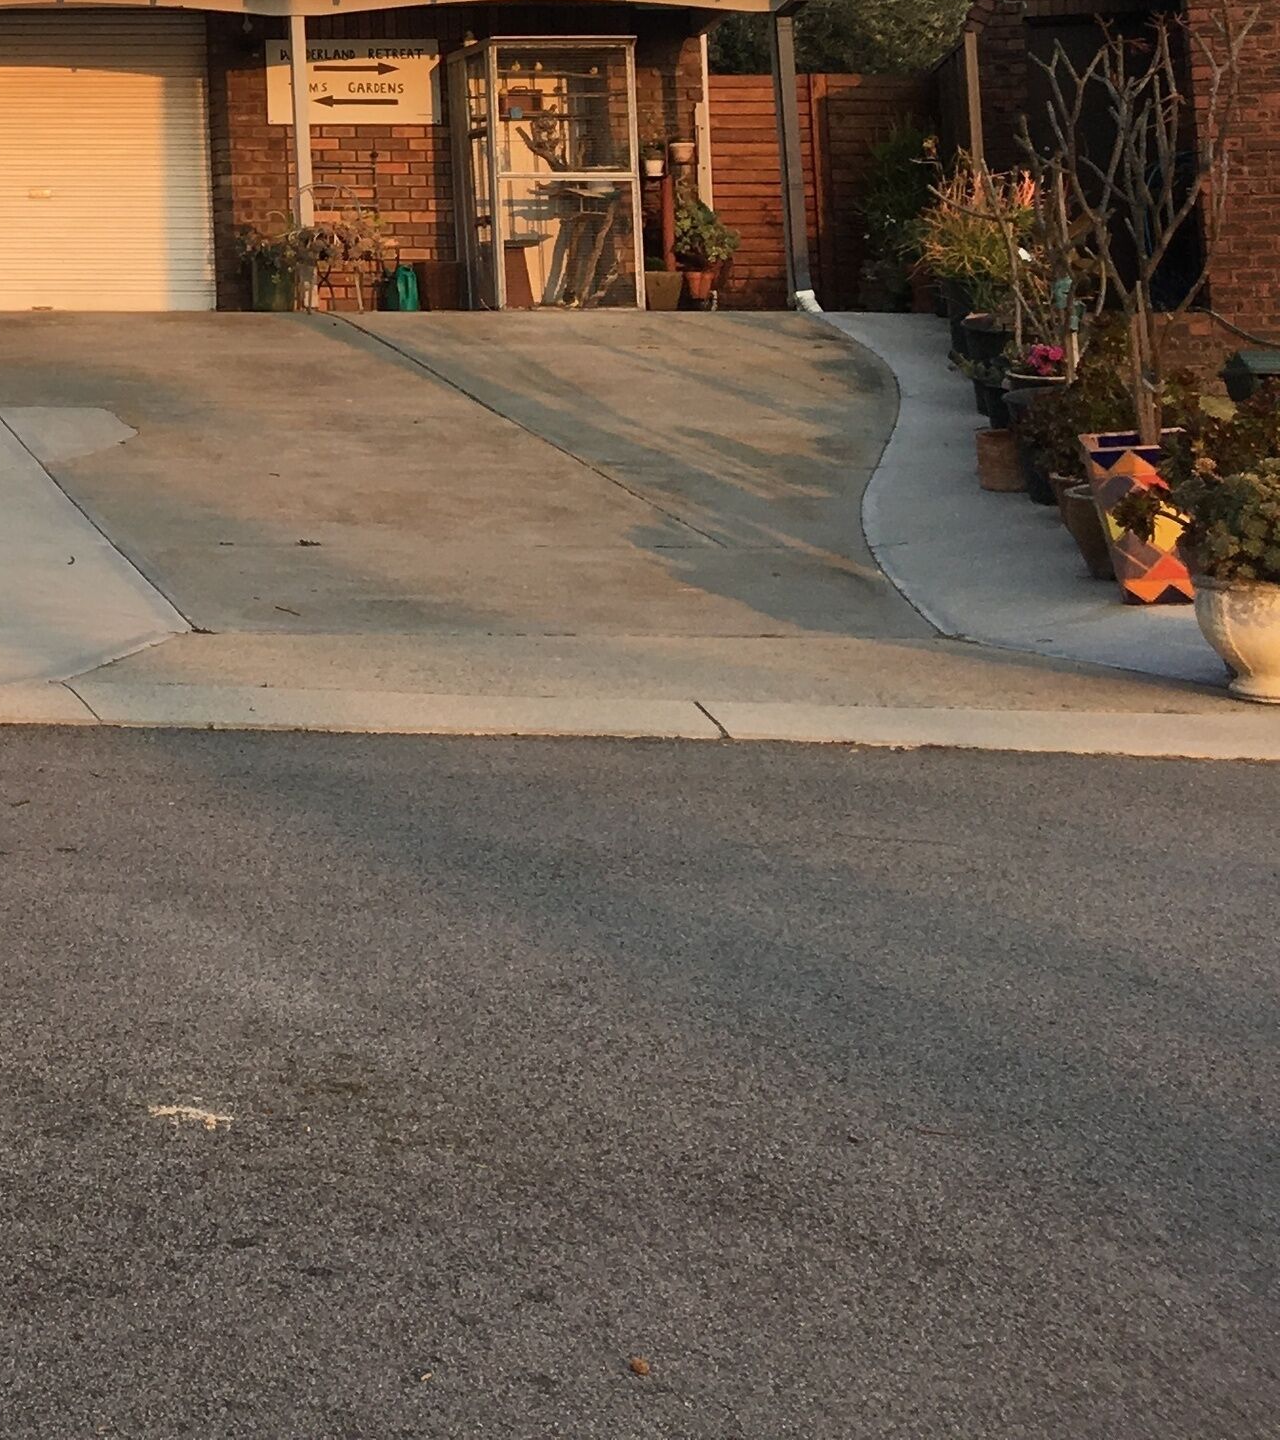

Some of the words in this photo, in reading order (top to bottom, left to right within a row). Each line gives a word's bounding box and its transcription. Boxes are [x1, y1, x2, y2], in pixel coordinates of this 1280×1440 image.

[280, 48, 356, 60] WDERLAND
[368, 48, 425, 59] RETREAT
[348, 81, 405, 94] GARDENS
